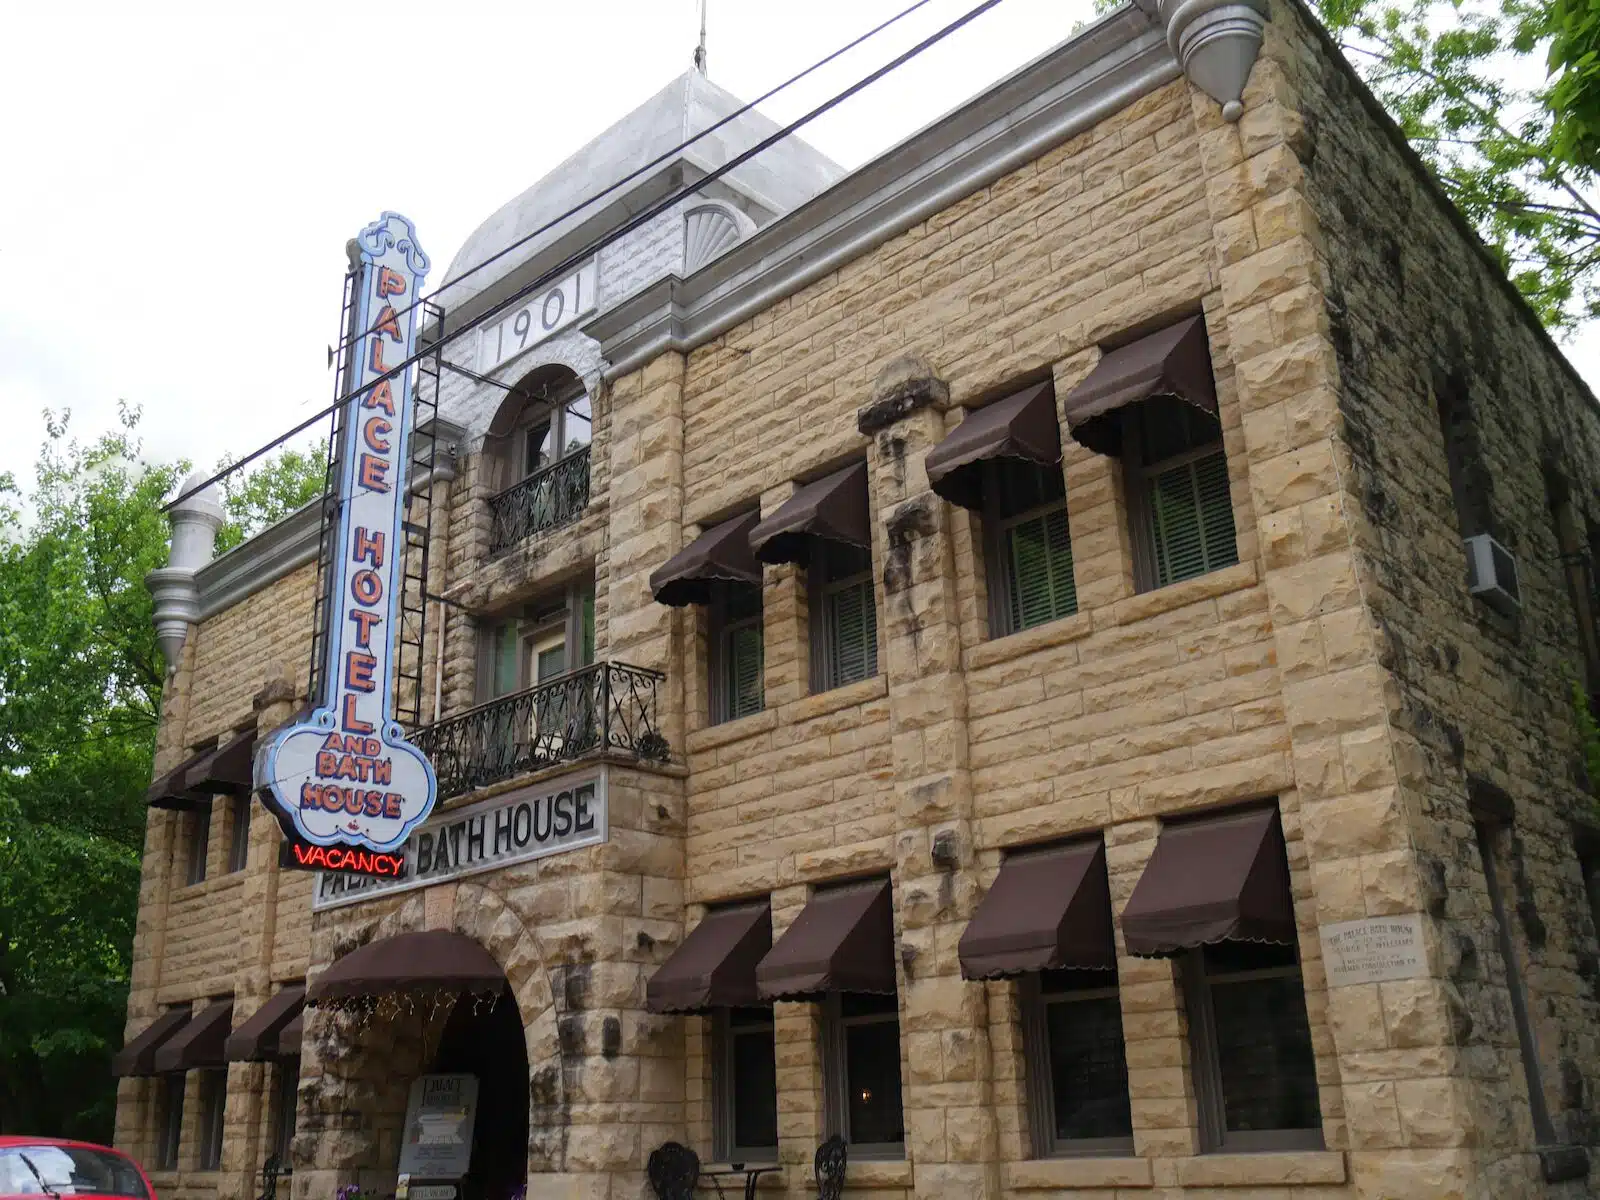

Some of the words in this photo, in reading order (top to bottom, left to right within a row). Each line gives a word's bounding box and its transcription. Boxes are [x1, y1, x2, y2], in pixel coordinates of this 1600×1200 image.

[496, 273, 581, 363] 1901
[358, 267, 406, 492] PALACE
[342, 526, 385, 735] HOTEL
[315, 752, 392, 786] BATH
[325, 733, 382, 757] AND
[300, 782, 402, 819] HOUSE
[415, 816, 486, 876] BATH
[492, 783, 596, 856] HOUSE
[293, 843, 404, 876] VACANCY
